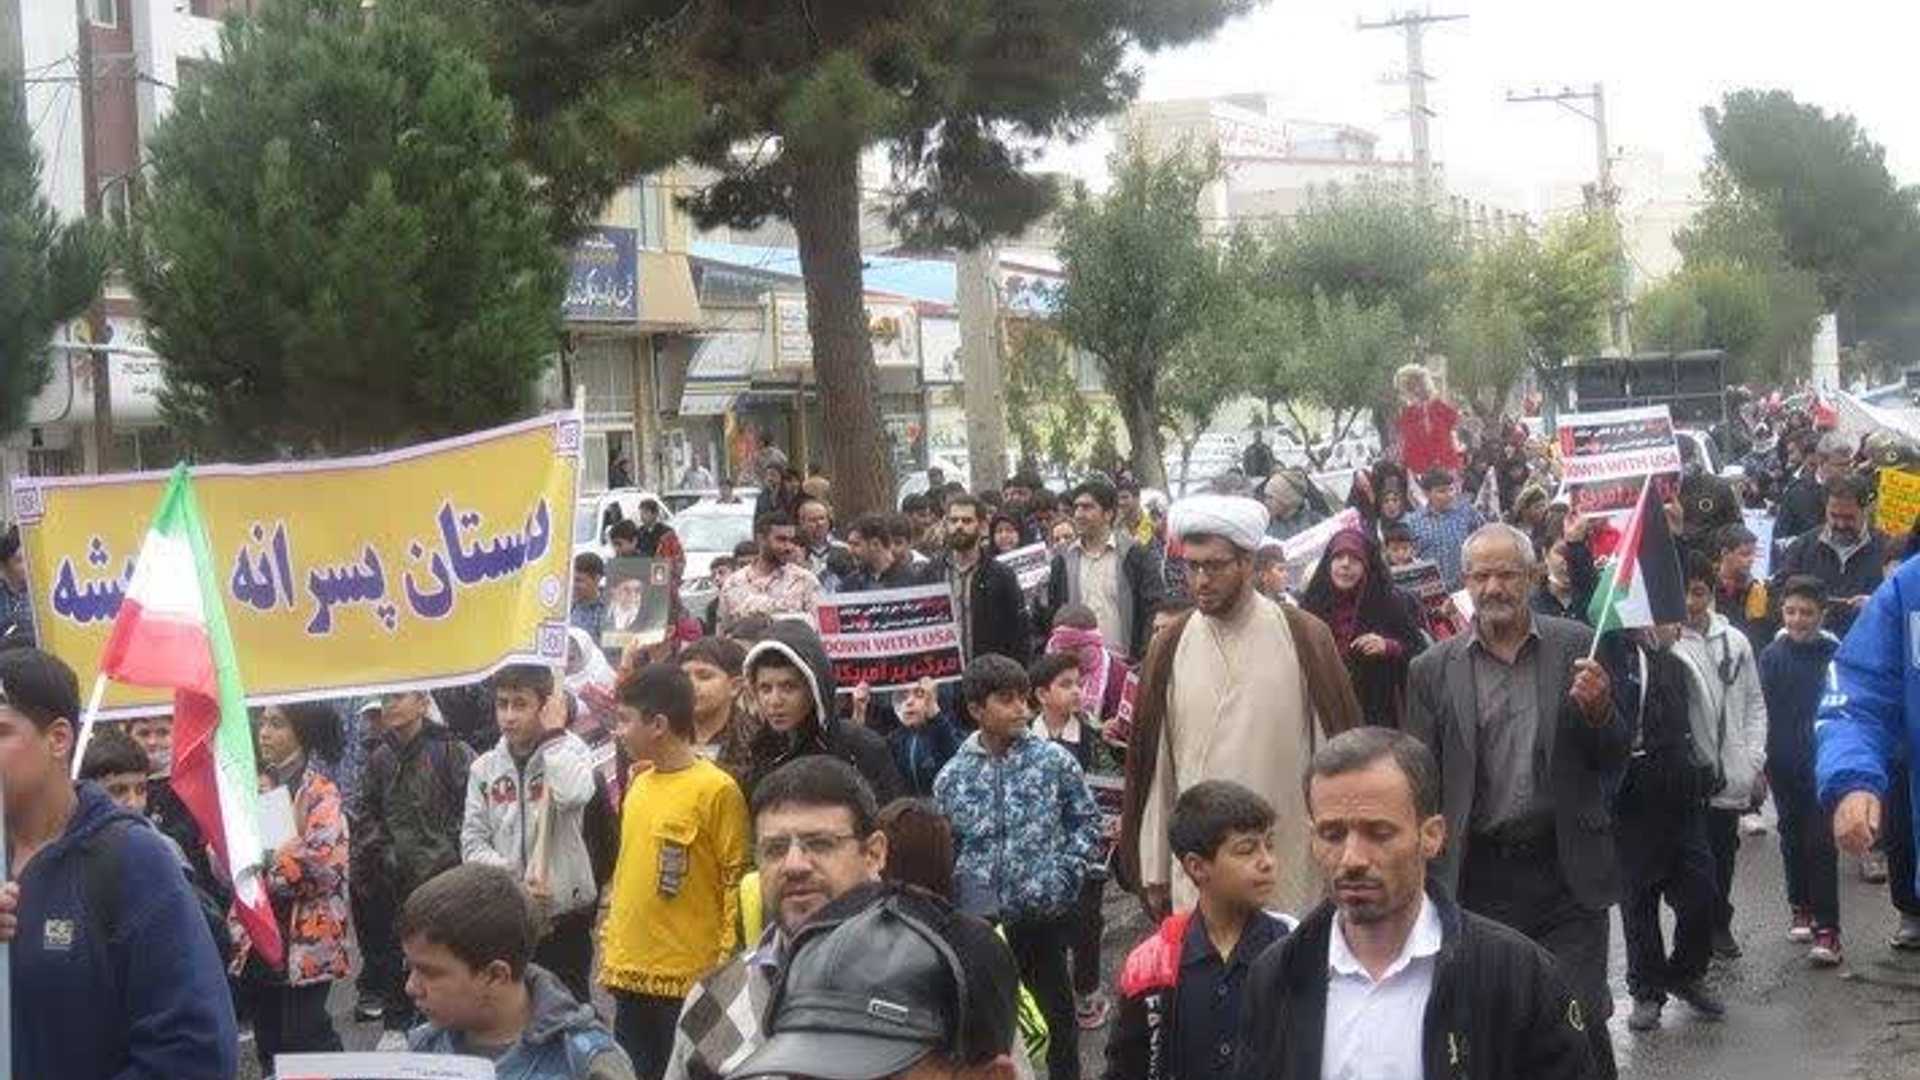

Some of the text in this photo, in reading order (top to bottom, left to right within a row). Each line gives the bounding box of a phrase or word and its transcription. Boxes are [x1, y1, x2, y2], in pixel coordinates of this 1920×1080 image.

[1651, 451, 1678, 468] USA
[873, 633, 919, 651] WITH
[921, 628, 954, 645] USA
